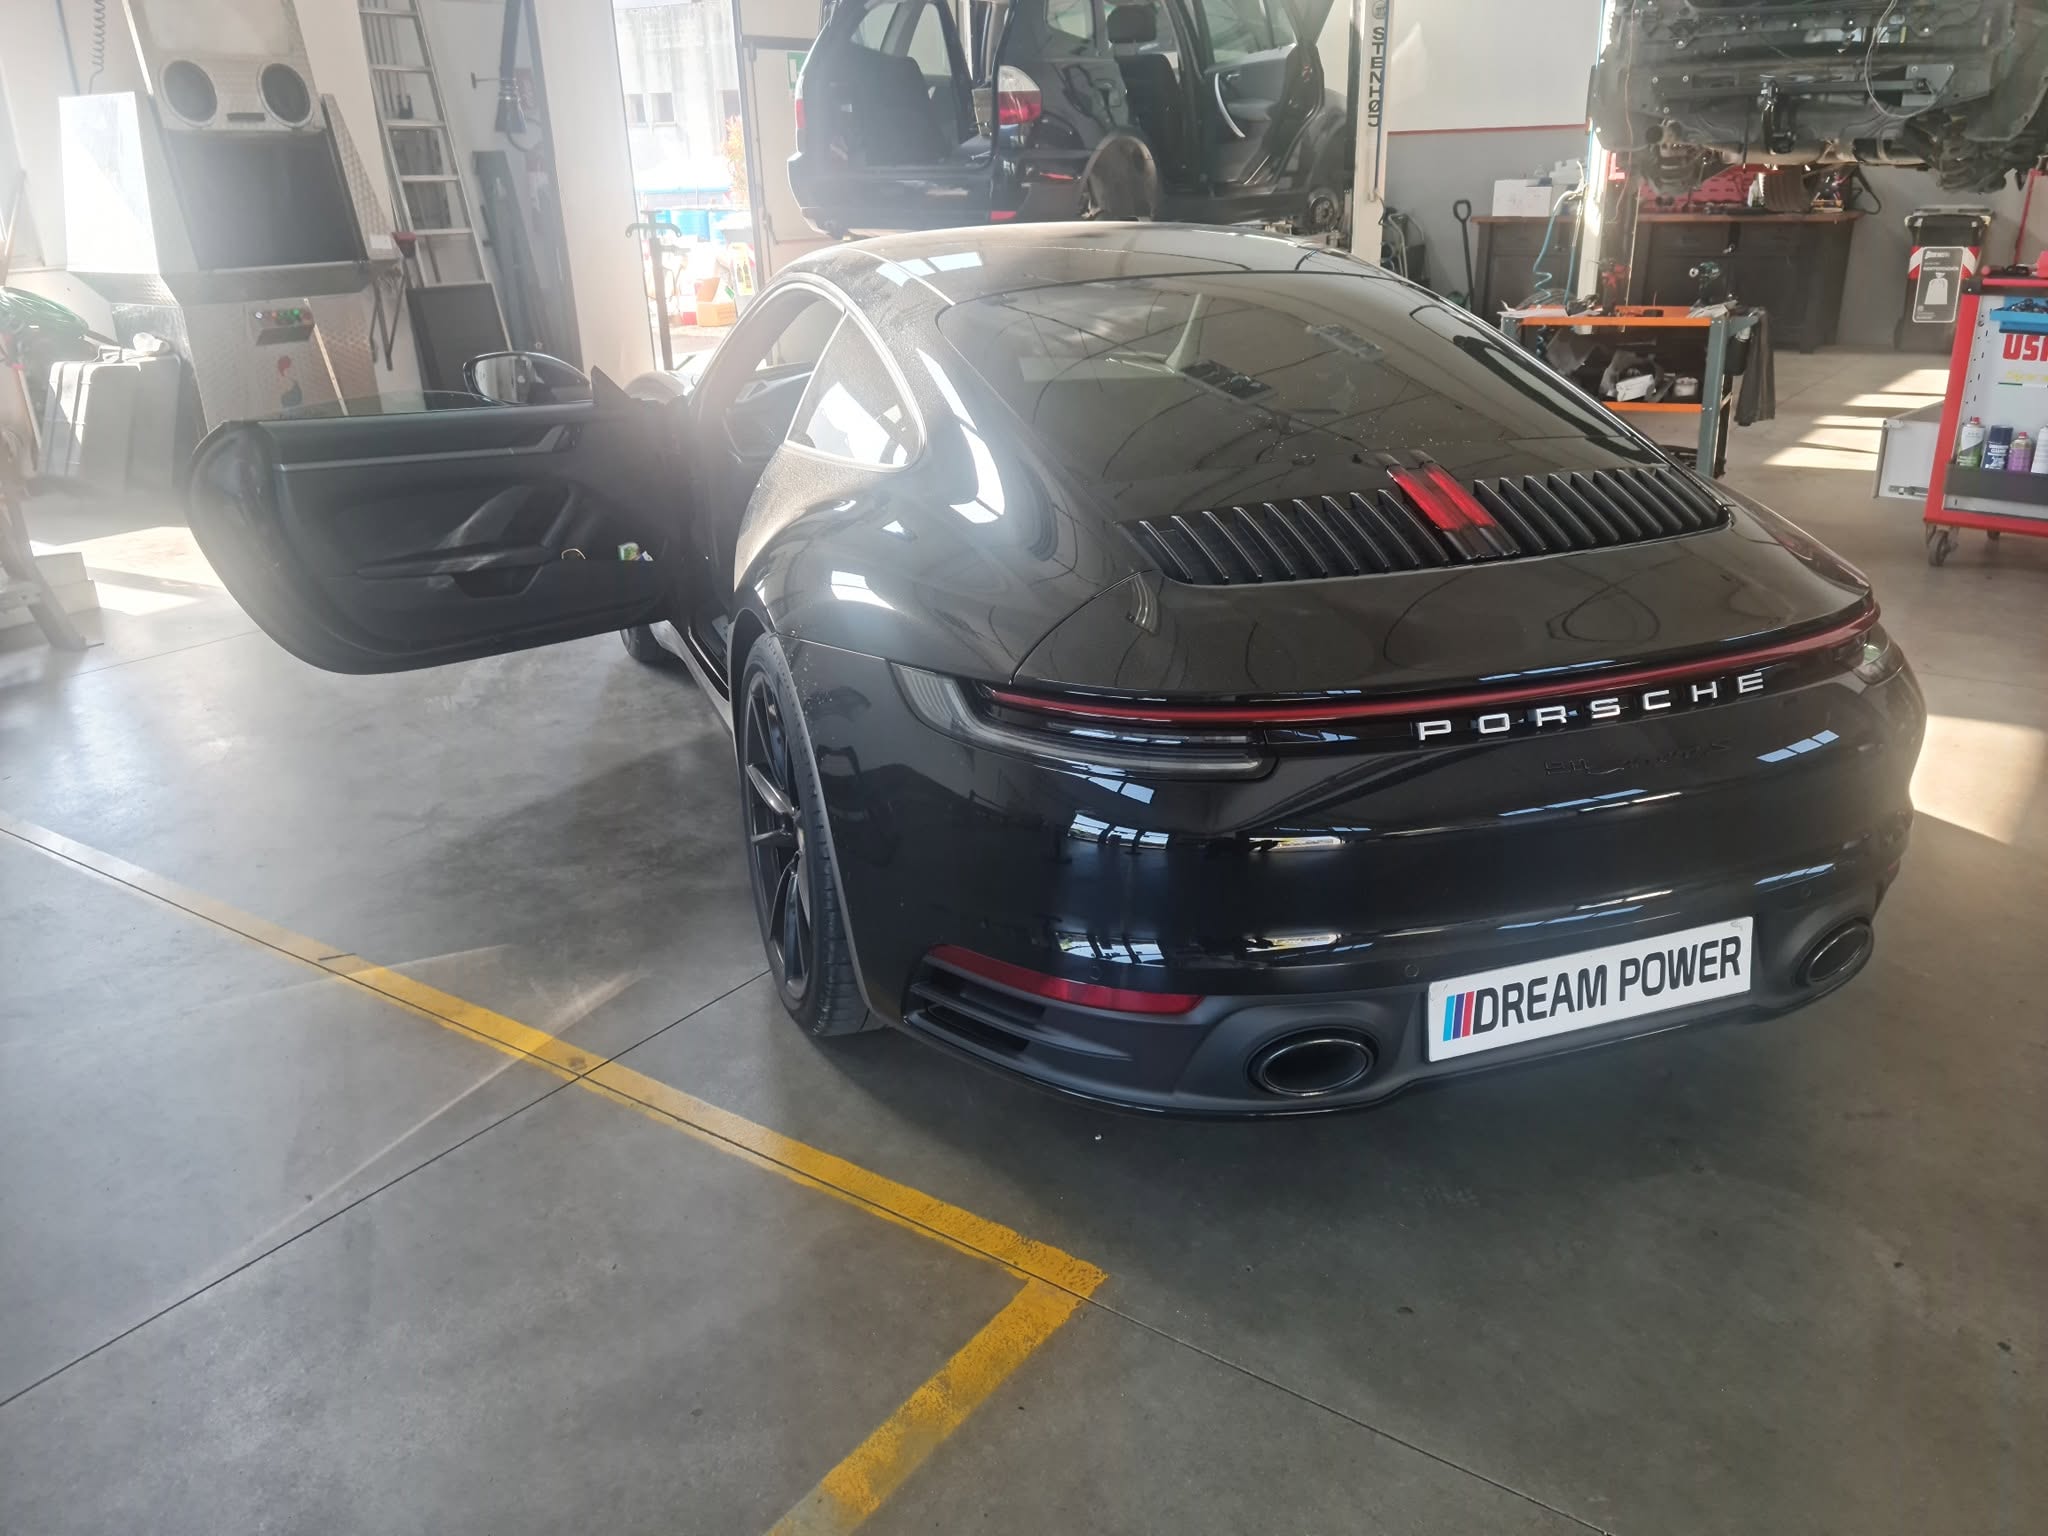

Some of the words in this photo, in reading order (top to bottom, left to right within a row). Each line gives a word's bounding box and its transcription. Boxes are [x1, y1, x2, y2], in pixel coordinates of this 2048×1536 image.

[1417, 672, 1765, 741] PORSCHE
[1472, 964, 1608, 1035] DREAM
[1619, 935, 1742, 1002] POWER
